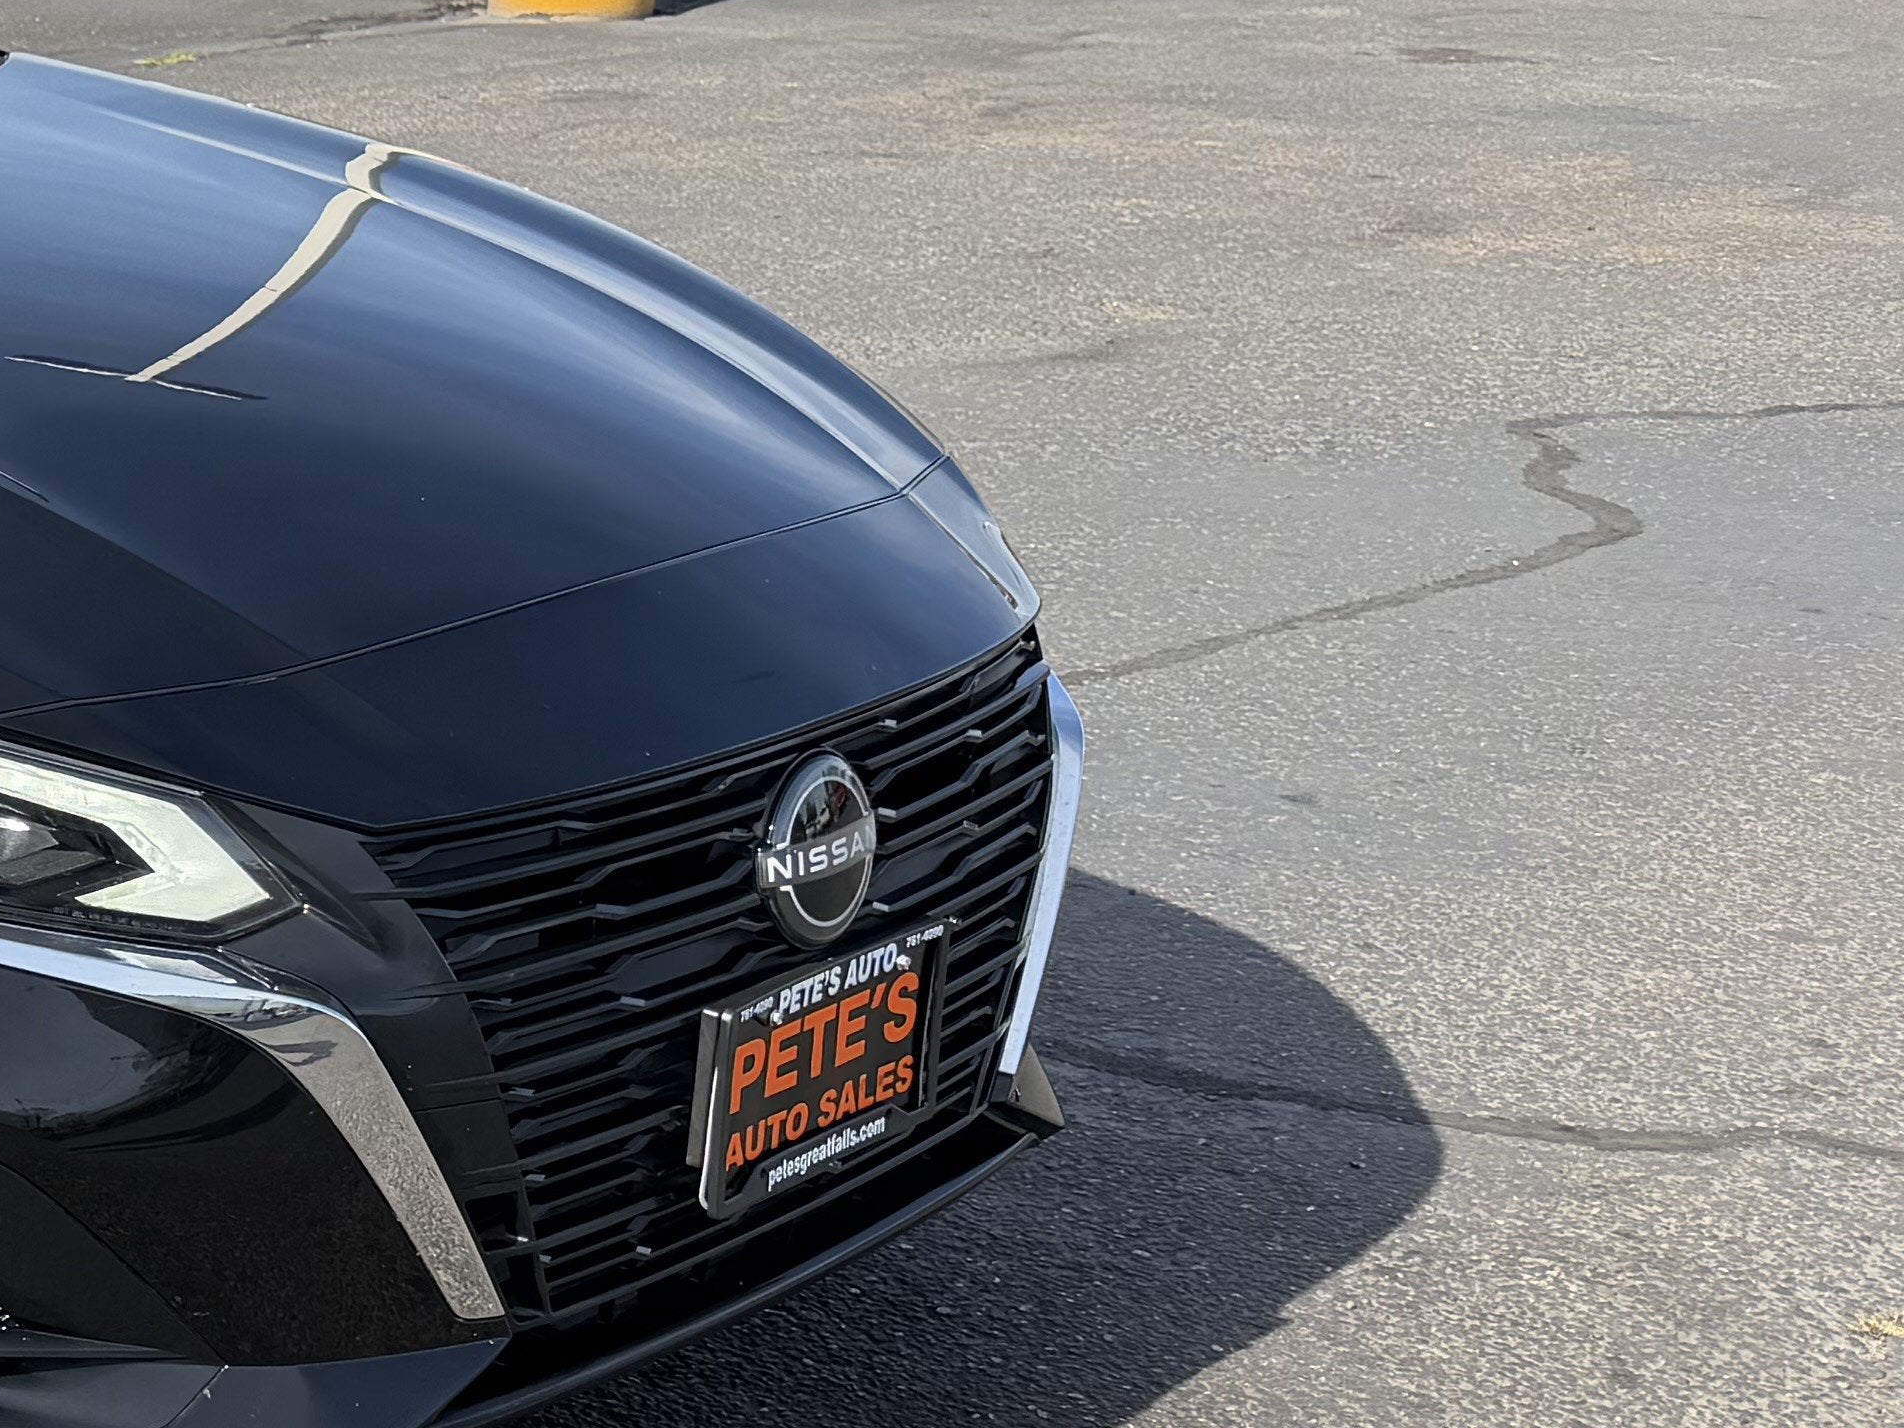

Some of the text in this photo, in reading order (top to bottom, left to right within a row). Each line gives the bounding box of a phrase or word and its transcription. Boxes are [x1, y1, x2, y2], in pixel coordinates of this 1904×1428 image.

[766, 822, 877, 884] NISSAN
[778, 942, 898, 1017] PETE'S AUTO
[728, 971, 920, 1116] PETE'S
[725, 1054, 914, 1172] AUTO SALES
[767, 1116, 886, 1193] petesgreatfalls.com
